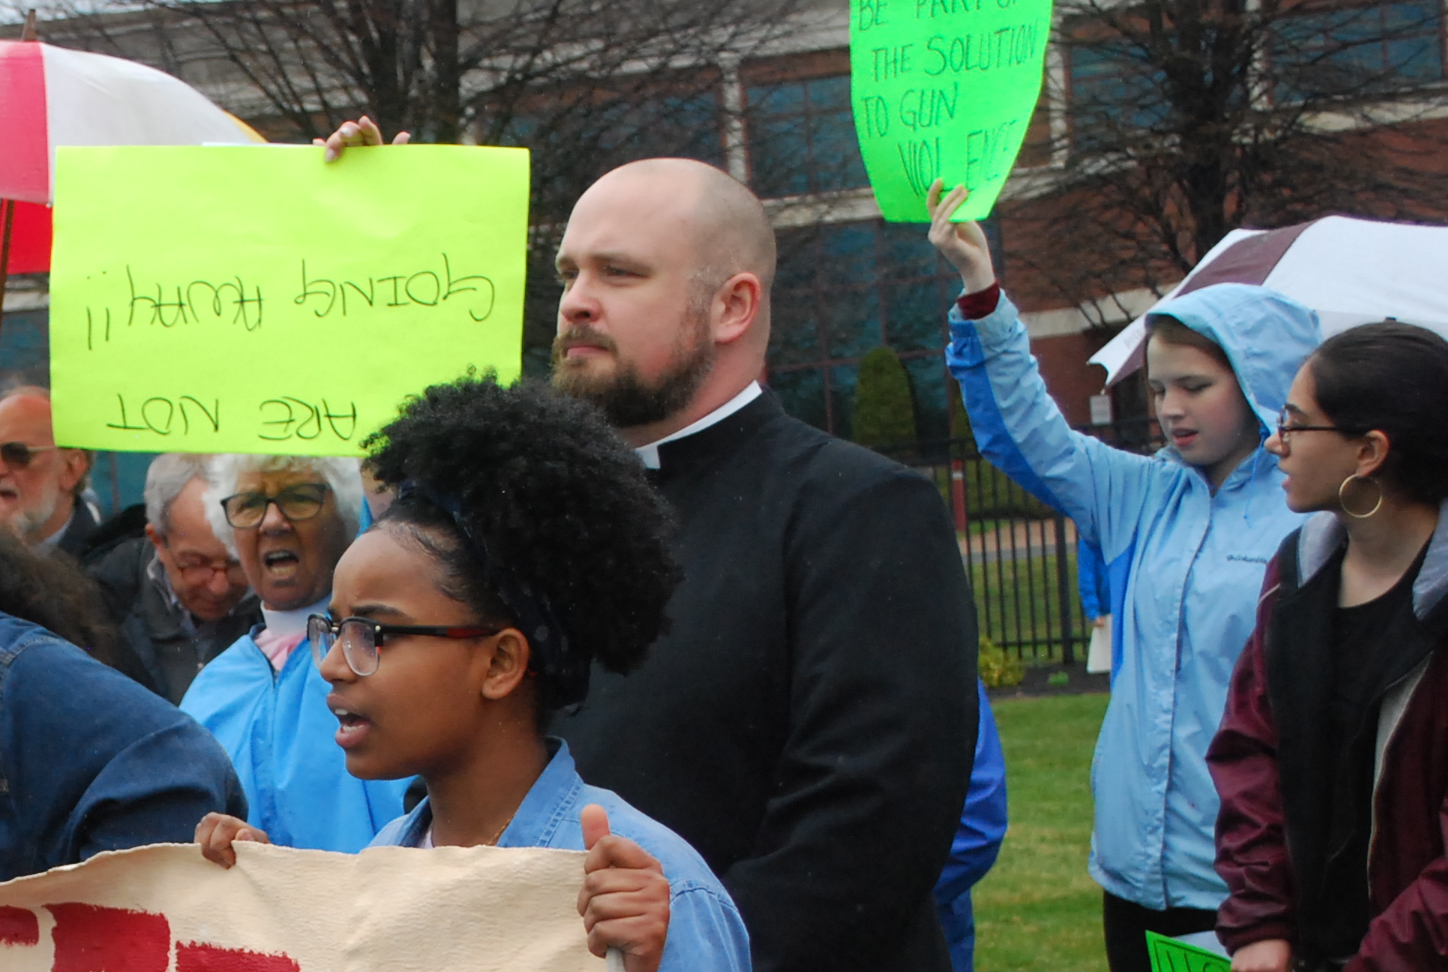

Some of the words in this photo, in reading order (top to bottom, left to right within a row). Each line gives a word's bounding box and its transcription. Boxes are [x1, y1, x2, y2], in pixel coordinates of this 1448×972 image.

[872, 44, 913, 82] THE
[924, 19, 1038, 77] SOLUTION
[861, 95, 889, 137] TO
[899, 82, 958, 131] GUN
[293, 252, 495, 323] GOING
[106, 393, 219, 436] NOT
[258, 395, 357, 442] ARE
